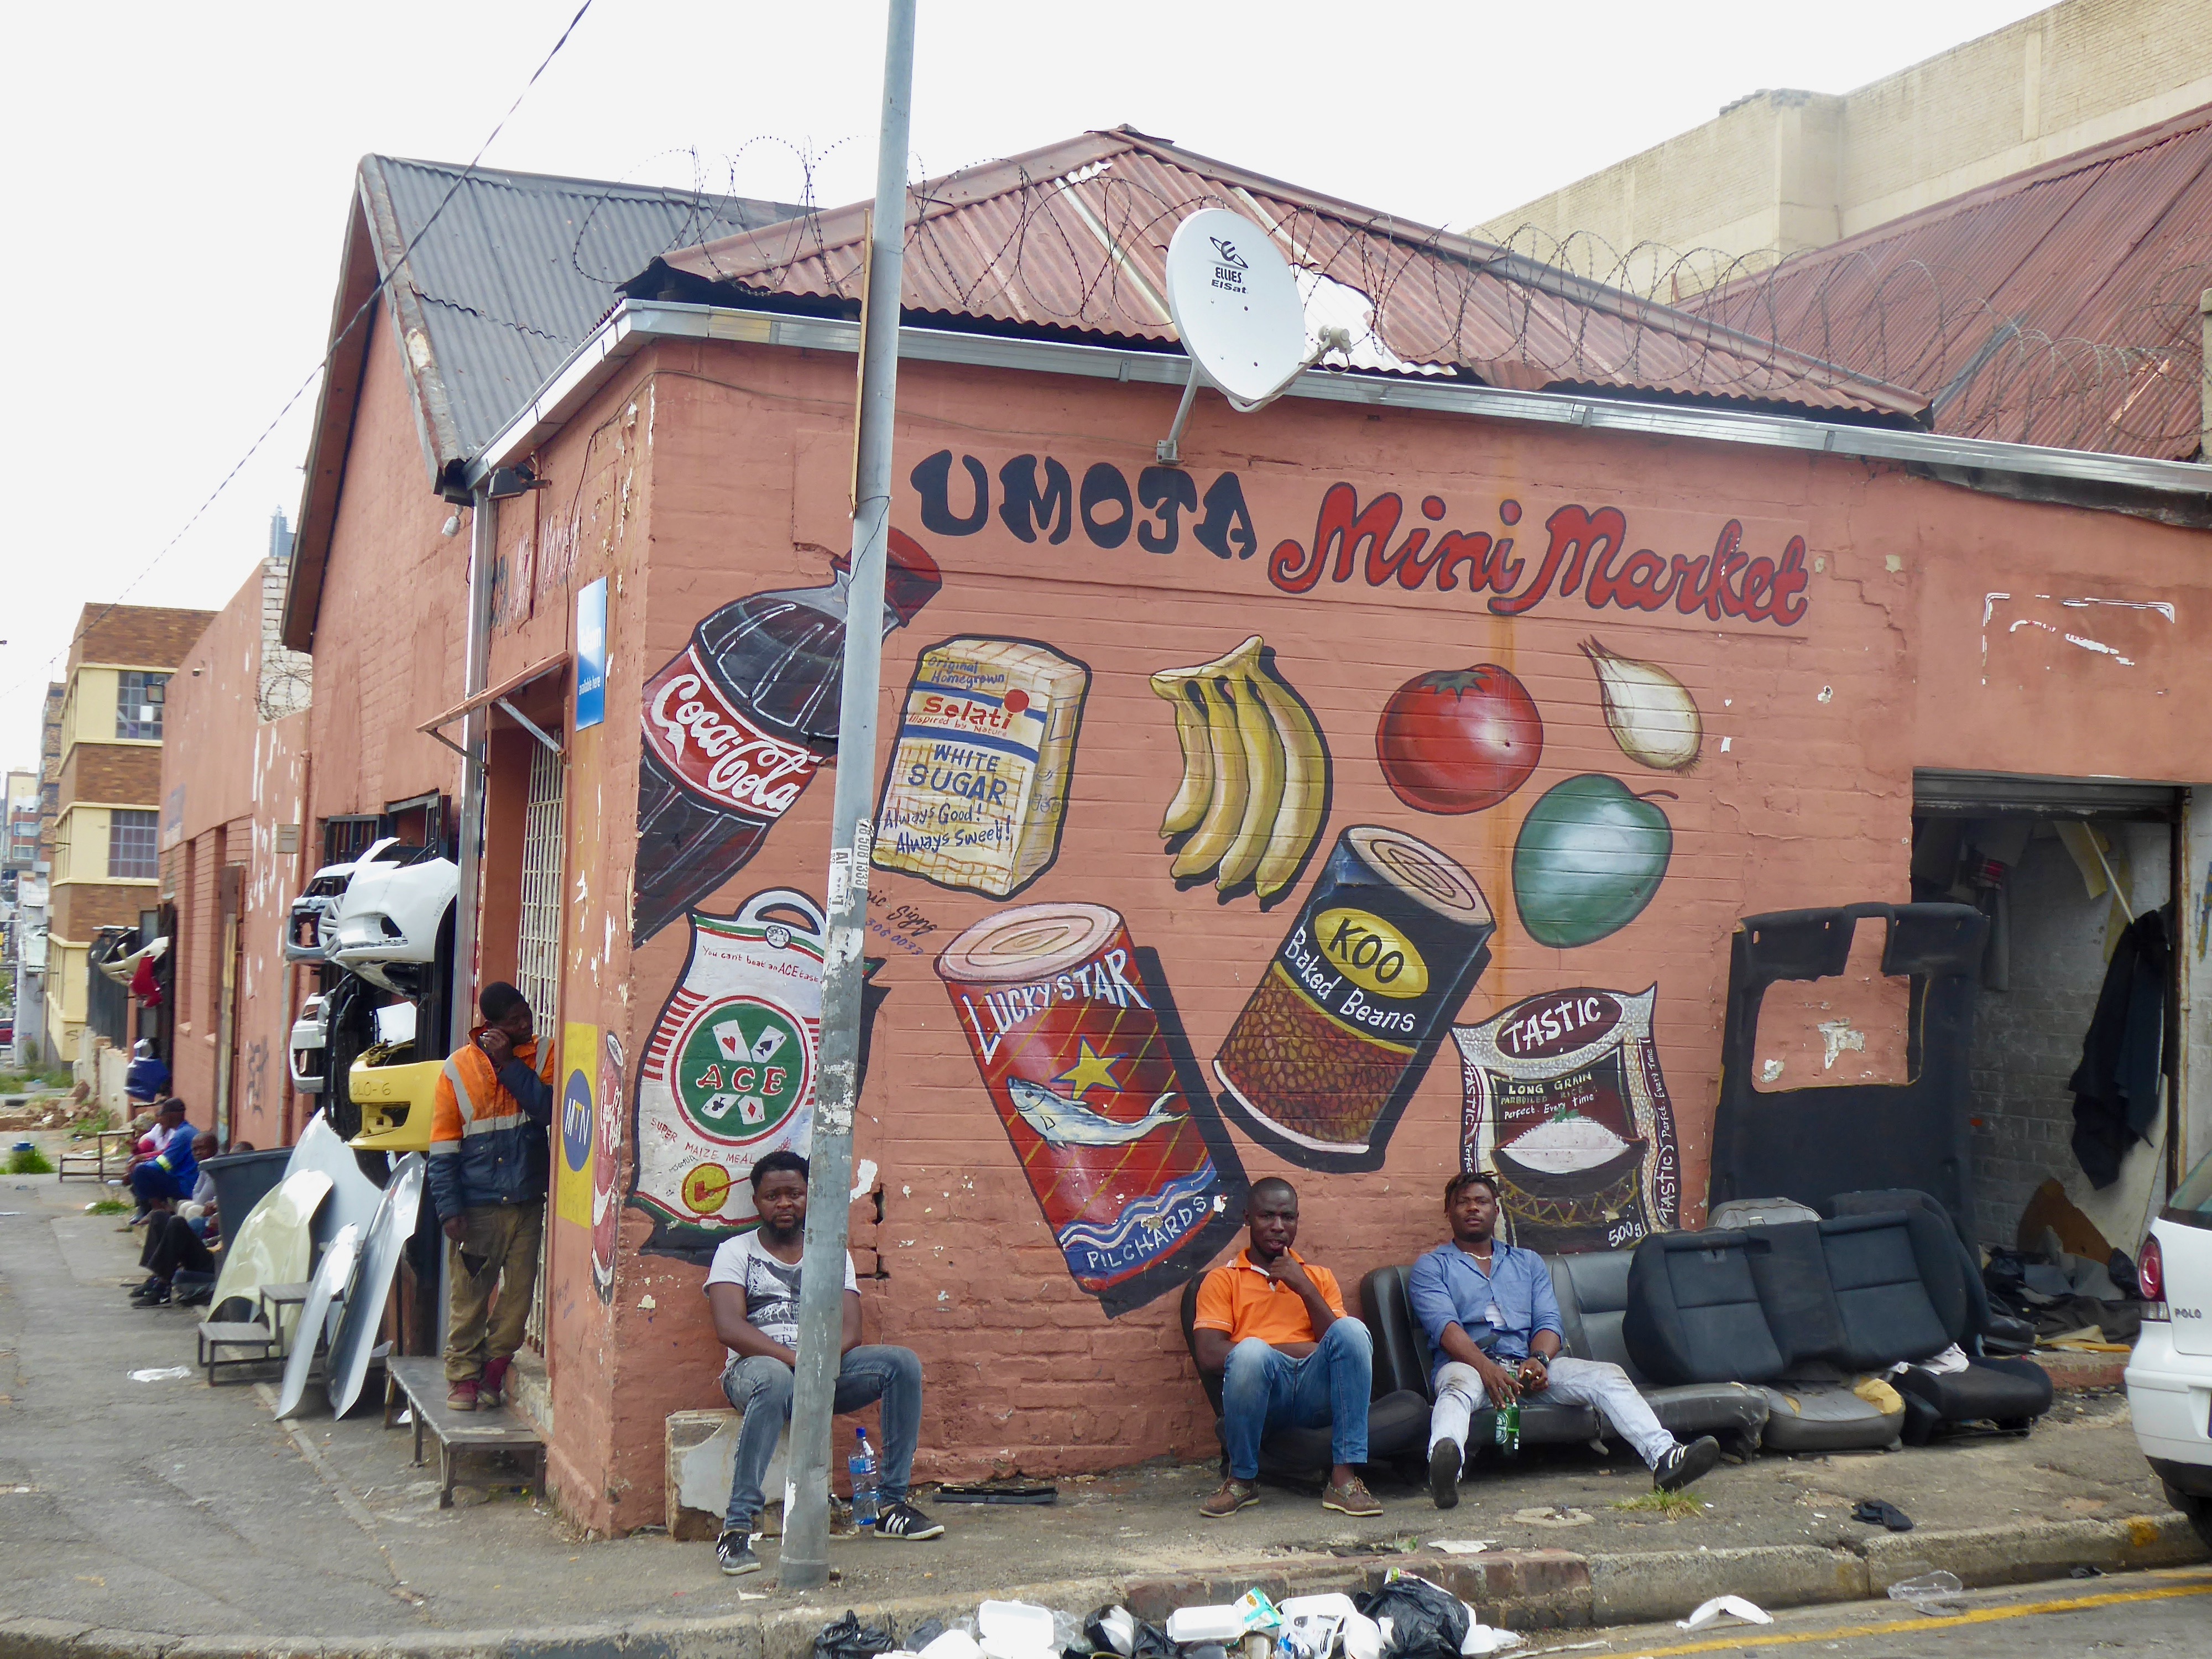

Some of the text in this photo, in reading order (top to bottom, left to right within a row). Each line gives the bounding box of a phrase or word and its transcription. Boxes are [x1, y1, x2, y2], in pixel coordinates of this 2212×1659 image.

[1215, 267, 1241, 283] ELLIES
[910, 449, 1809, 627] UMOJA Mini Market
[927, 656, 978, 674] Original
[592, 675, 600, 690] here
[931, 671, 1005, 690] Homegrown
[923, 692, 1016, 729] Selati
[954, 719, 967, 729] by
[973, 725, 1008, 737] Nature
[933, 744, 1001, 772] WHITE
[907, 764, 1007, 806] SUGAR
[883, 802, 982, 831] Always Good!
[857, 837, 870, 859] 508
[895, 832, 950, 856] Always
[854, 860, 869, 887] 1333
[702, 945, 717, 957] You
[721, 953, 743, 962] can't
[747, 955, 766, 968] beat
[768, 963, 778, 971] an
[778, 962, 800, 978] ACE
[1327, 917, 1404, 984] KOO
[1285, 926, 1416, 1032] Baked Beans
[961, 948, 1154, 1066] LUCKY STAR
[1501, 997, 1601, 1054] TASTIC
[697, 1063, 787, 1096] ACE
[1509, 1071, 1592, 1095] LONG GRAIN
[1653, 1073, 1665, 1098] Every
[1500, 1086, 1585, 1105] PARBOILED RICE
[1543, 1102, 1566, 1114] Every
[1572, 1093, 1594, 1107] time
[564, 1098, 591, 1146] MTN
[1464, 1066, 1477, 1174] TASTIC Perfec
[650, 1117, 756, 1165] SUPER MAIZE MEAL
[1656, 1156, 1676, 1219] TASTIC
[1086, 1196, 1208, 1269] PILCHARDS
[1608, 1220, 1642, 1248] 500g
[2174, 1308, 2202, 1319] POLO
